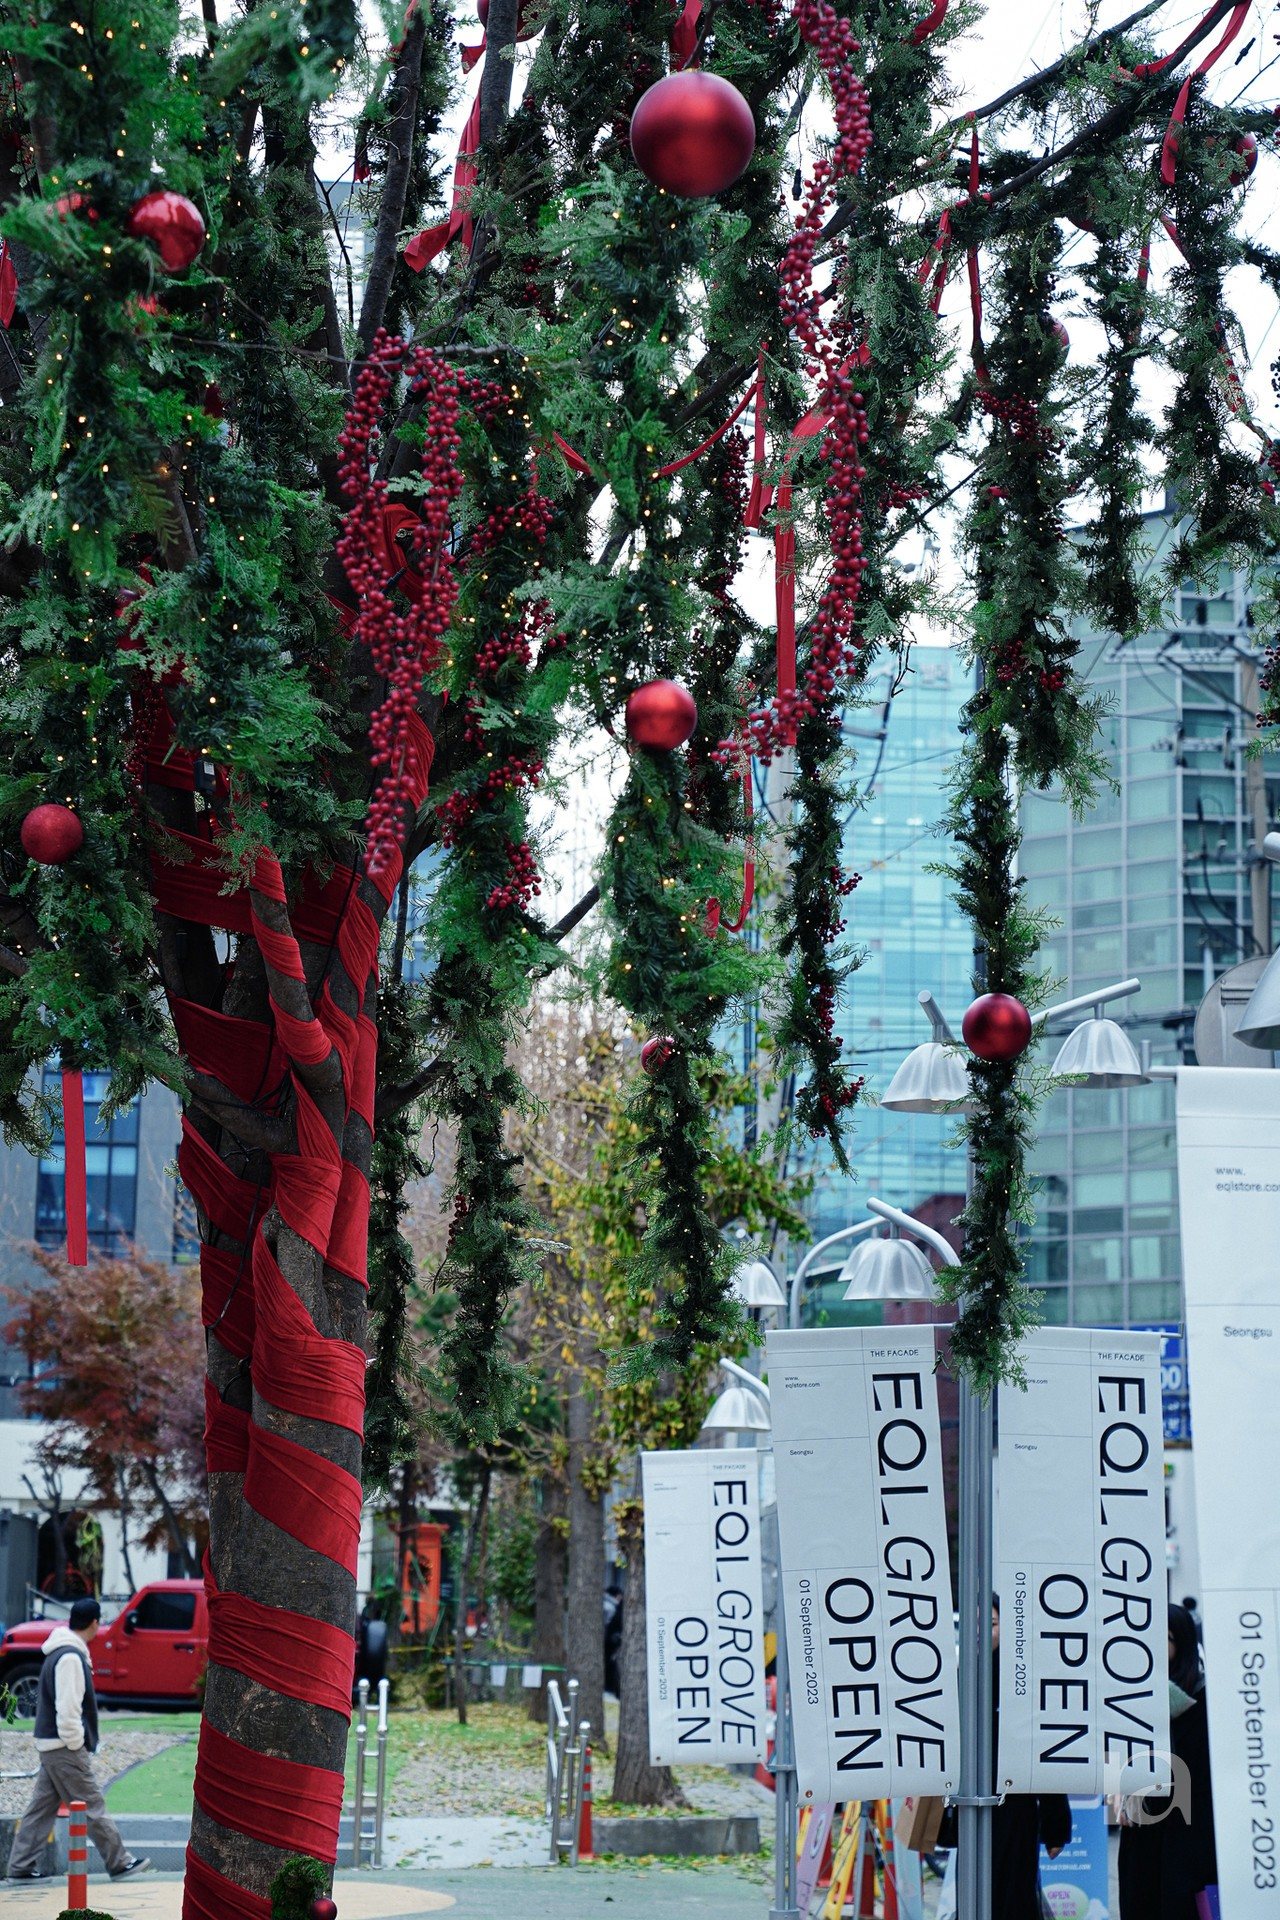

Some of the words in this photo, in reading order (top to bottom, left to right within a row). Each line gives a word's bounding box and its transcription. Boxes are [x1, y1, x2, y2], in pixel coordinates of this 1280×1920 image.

[1215, 1167, 1246, 1176] www.
[1215, 1181, 1280, 1192] eqlstore.co
[870, 1350, 886, 1358] THE
[887, 1349, 919, 1357] FACADE
[1223, 1326, 1273, 1339] Seongsu
[872, 1372, 929, 1526] EQL
[1098, 1375, 1149, 1526] EQL
[713, 1480, 750, 1583] EQL
[799, 1579, 811, 1594] 01
[1015, 1572, 1026, 1589] 01
[657, 1617, 666, 1628] 01
[657, 1629, 666, 1676] September
[799, 1597, 815, 1669] September
[883, 1536, 946, 1773] GROVE
[1013, 1590, 1027, 1660] September
[1100, 1537, 1156, 1774] GROVE
[1239, 1611, 1263, 1641] 01
[659, 1678, 668, 1701] 2023
[674, 1616, 712, 1745] OPEN
[716, 1589, 757, 1747] GROVE
[805, 1671, 819, 1705] 2023
[824, 1577, 884, 1772] OPEN
[1015, 1663, 1027, 1696] 2023
[1039, 1573, 1090, 1764] OPEN
[1238, 1652, 1272, 1809] September
[1251, 1818, 1277, 1890] 2023
